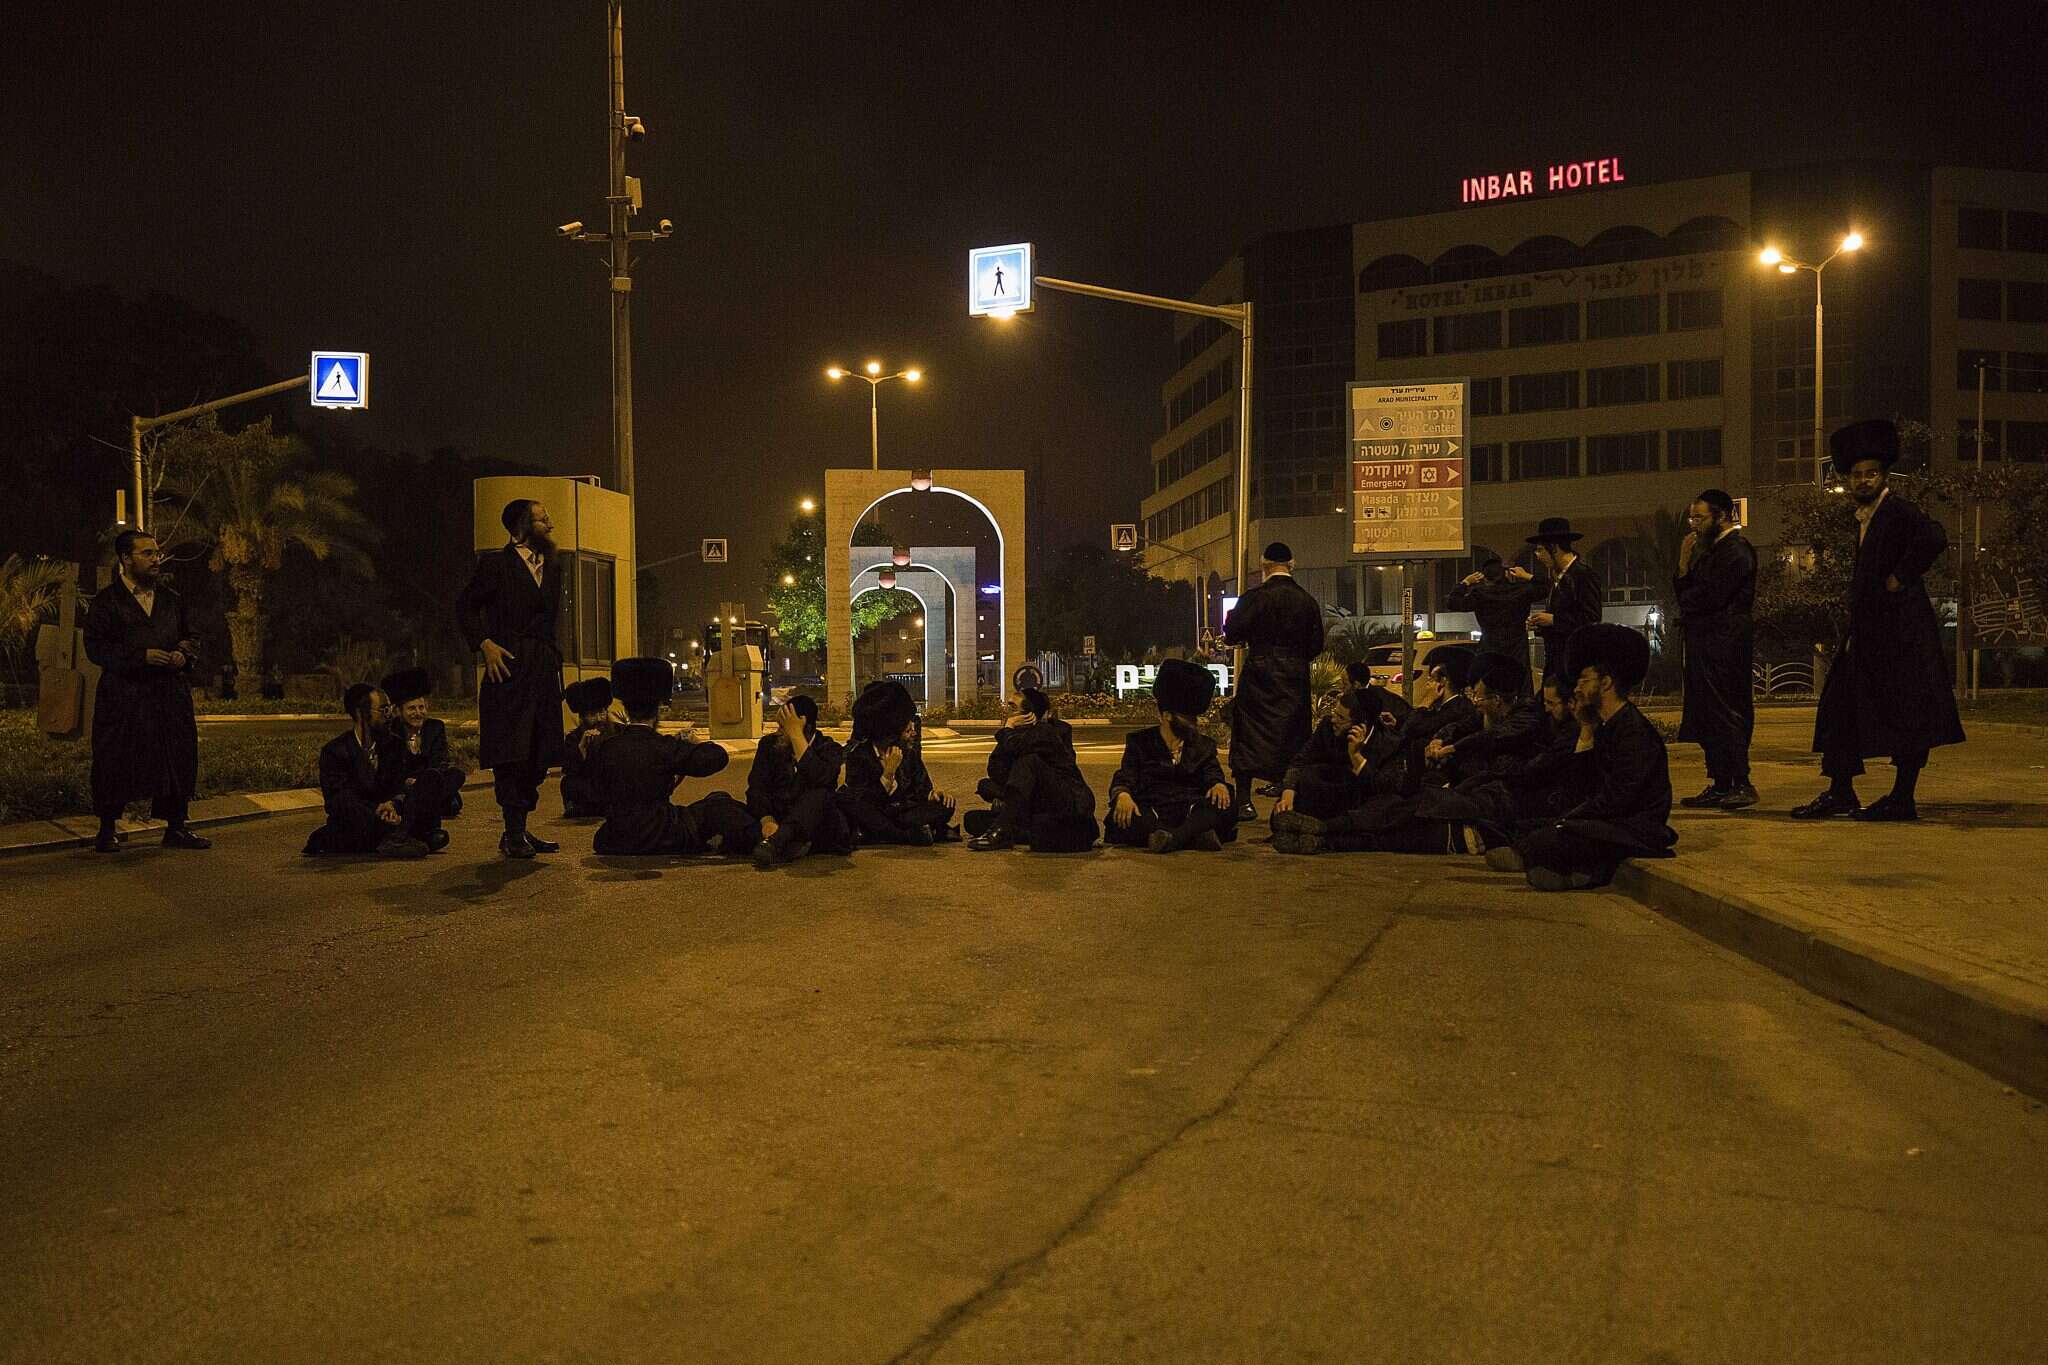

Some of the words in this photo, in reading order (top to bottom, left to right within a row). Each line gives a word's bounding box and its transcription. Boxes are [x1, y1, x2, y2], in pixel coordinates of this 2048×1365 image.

[1462, 170, 1534, 203] INBAR
[1548, 156, 1625, 191] HOTEL
[1405, 289, 1463, 310] HOTEL
[1395, 394, 1439, 403] MUNICIPALITY
[1397, 410, 1424, 421] העיר
[1427, 408, 1456, 421] מרכז
[1422, 422, 1456, 434] Center
[1360, 444, 1399, 457] משטרה
[1408, 443, 1440, 455] עירייה
[1361, 464, 1391, 478] קדמי
[1393, 463, 1415, 478] מיון
[1361, 479, 1407, 489] Emergency
[1361, 494, 1400, 505] Masada
[1406, 491, 1440, 503] מצדה
[1420, 505, 1441, 517] בתי
